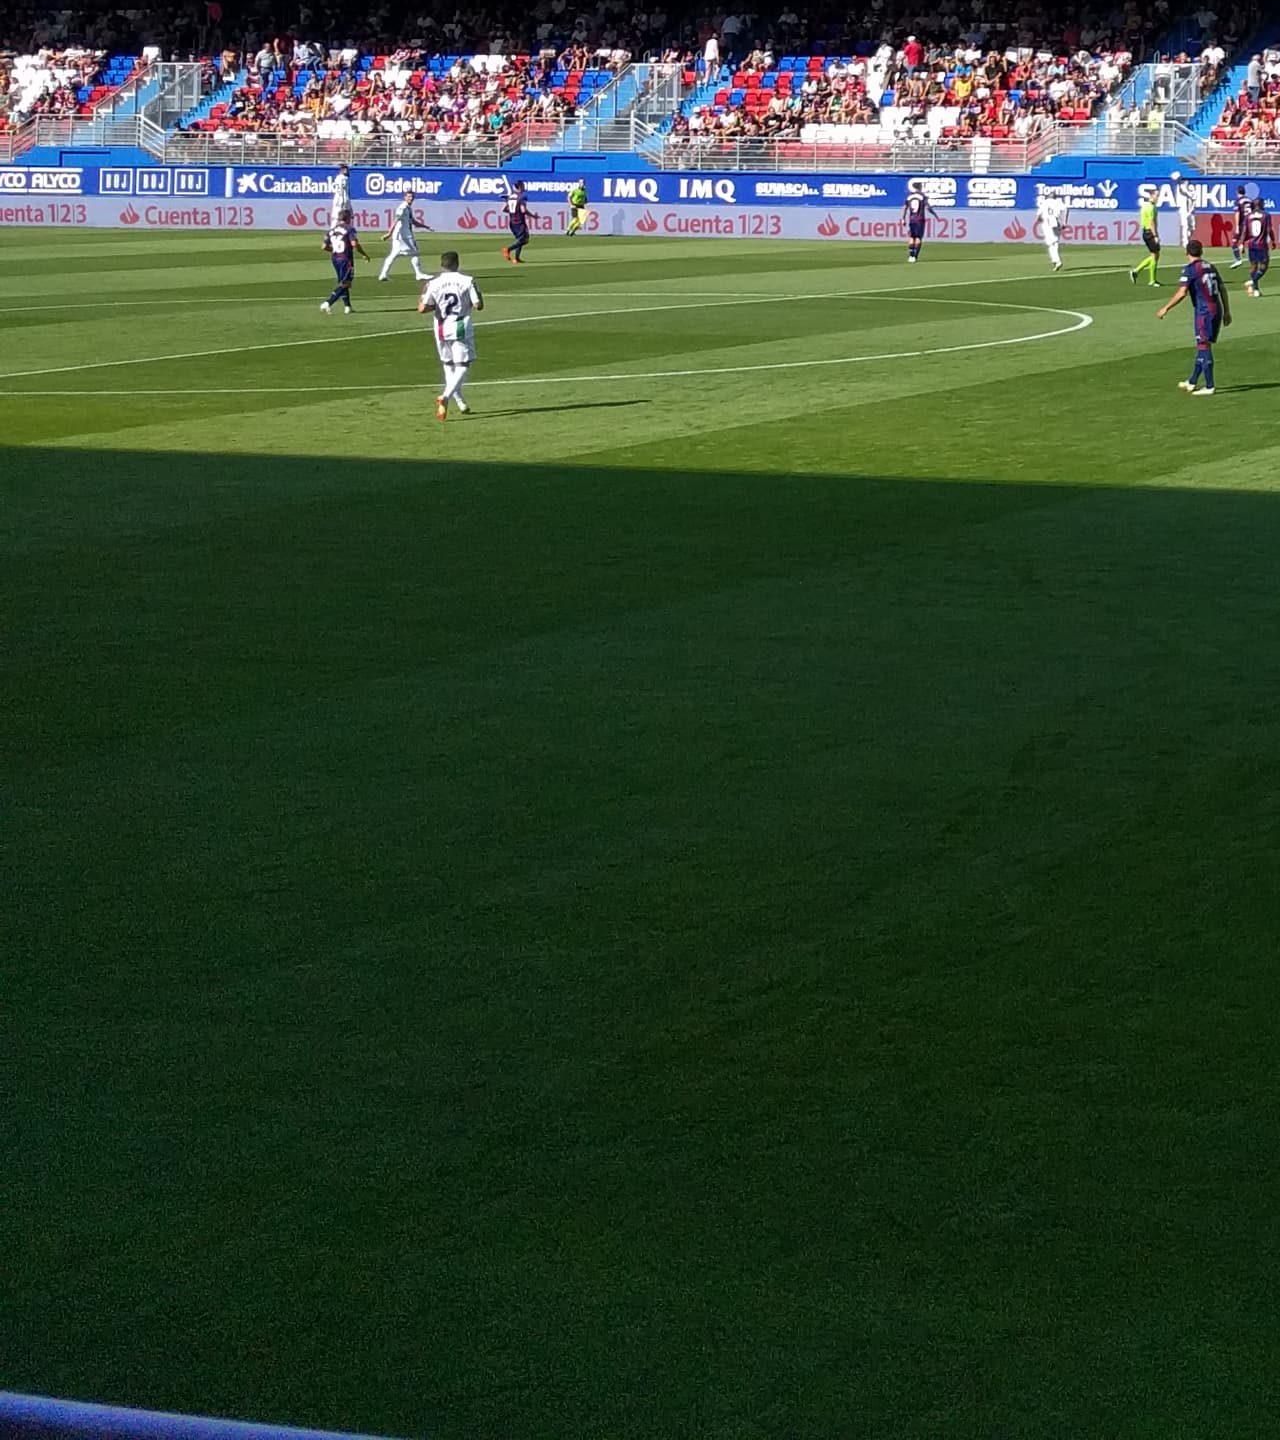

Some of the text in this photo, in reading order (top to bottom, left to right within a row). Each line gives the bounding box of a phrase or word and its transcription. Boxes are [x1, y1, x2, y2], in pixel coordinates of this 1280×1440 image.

[32, 172, 80, 189] ALYCO
[603, 178, 658, 202] IMQ
[679, 179, 736, 203] IMQ
[145, 205, 210, 225] Cuenta
[663, 212, 733, 234] Cuenta
[846, 216, 912, 237] Cuent
[444, 292, 460, 315] 2
